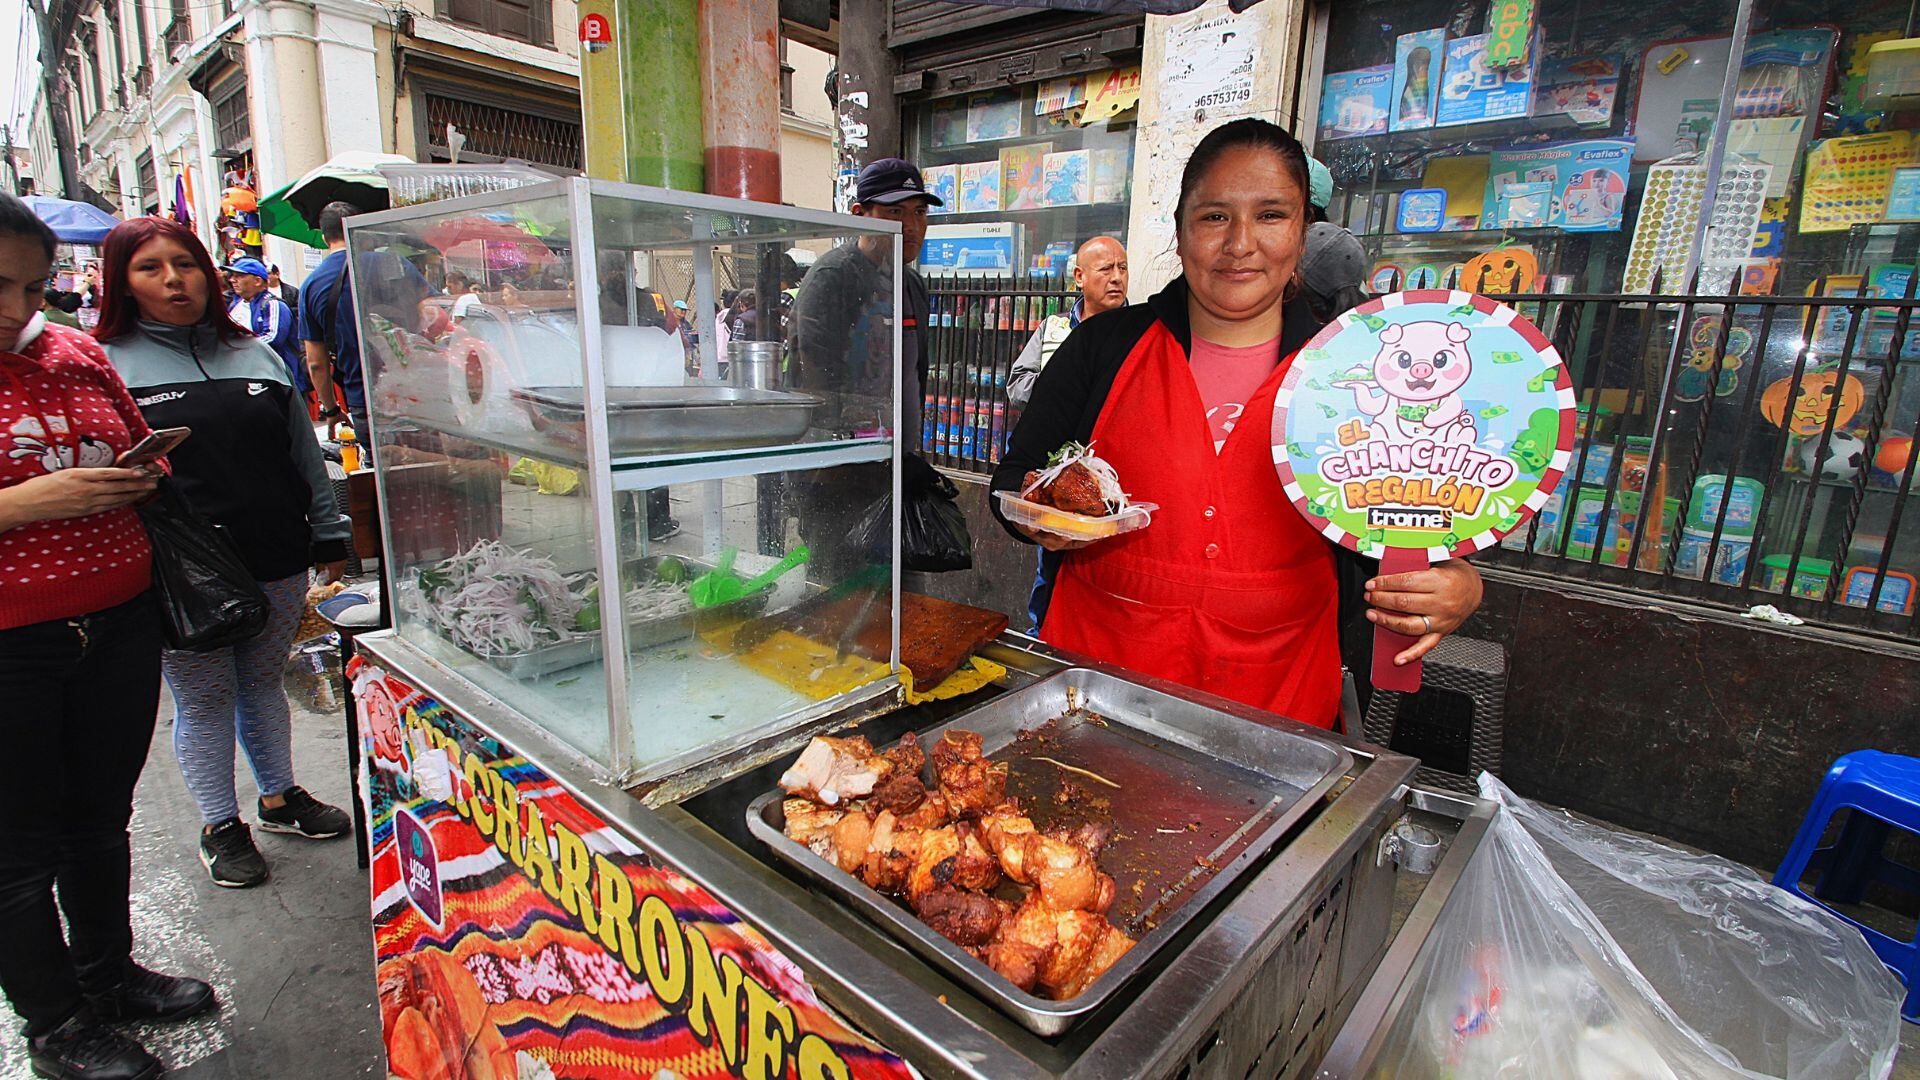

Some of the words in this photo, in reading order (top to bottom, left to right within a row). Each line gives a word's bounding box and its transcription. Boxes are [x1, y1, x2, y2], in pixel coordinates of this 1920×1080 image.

[587, 19, 601, 39] B
[1358, 75, 1385, 85] Evaflex
[1583, 150, 1620, 160] Evaflex
[1337, 420, 1371, 446] EL
[1321, 438, 1514, 488] CHANCHITO
[1344, 475, 1485, 514] REGALÓN
[1371, 510, 1444, 529] trome
[409, 857, 432, 893] yape
